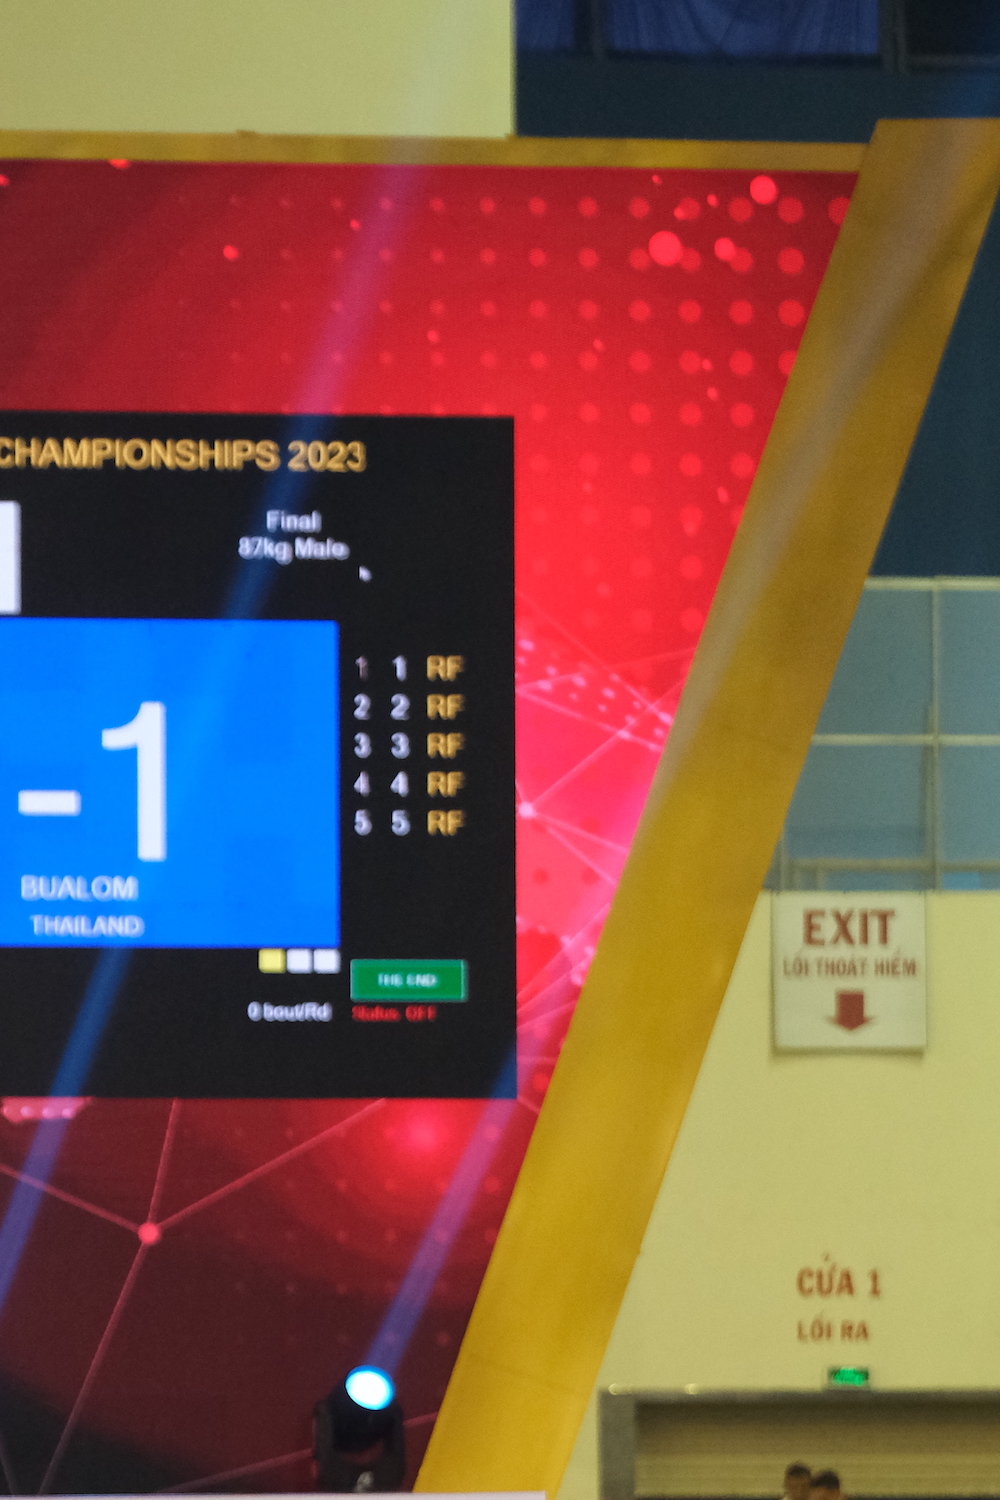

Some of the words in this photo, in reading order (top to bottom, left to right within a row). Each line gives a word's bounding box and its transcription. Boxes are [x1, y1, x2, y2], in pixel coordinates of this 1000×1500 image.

[287, 441, 367, 473] 2023
[265, 510, 322, 533] Final
[238, 537, 293, 565] 87kg
[294, 537, 350, 561] Male
[355, 656, 368, 678] 1
[392, 656, 407, 682] 1
[426, 655, 464, 682] RF
[353, 694, 372, 720] 2
[390, 694, 411, 720] 2
[426, 694, 464, 720] RF
[353, 732, 372, 759] 3
[390, 732, 411, 759] 3
[426, 732, 464, 759] RF
[353, 771, 372, 797] 4
[390, 771, 411, 797] 4
[426, 771, 464, 797] RF
[353, 810, 372, 836] 5
[390, 810, 411, 836] 5
[426, 810, 464, 836] RF
[21, 875, 138, 901] BUALOM
[31, 914, 144, 937] THAILAND
[802, 907, 897, 946] EXIT
[247, 1001, 262, 1022] 0
[868, 1268, 881, 1297] 1
[840, 1319, 869, 1342] RA
